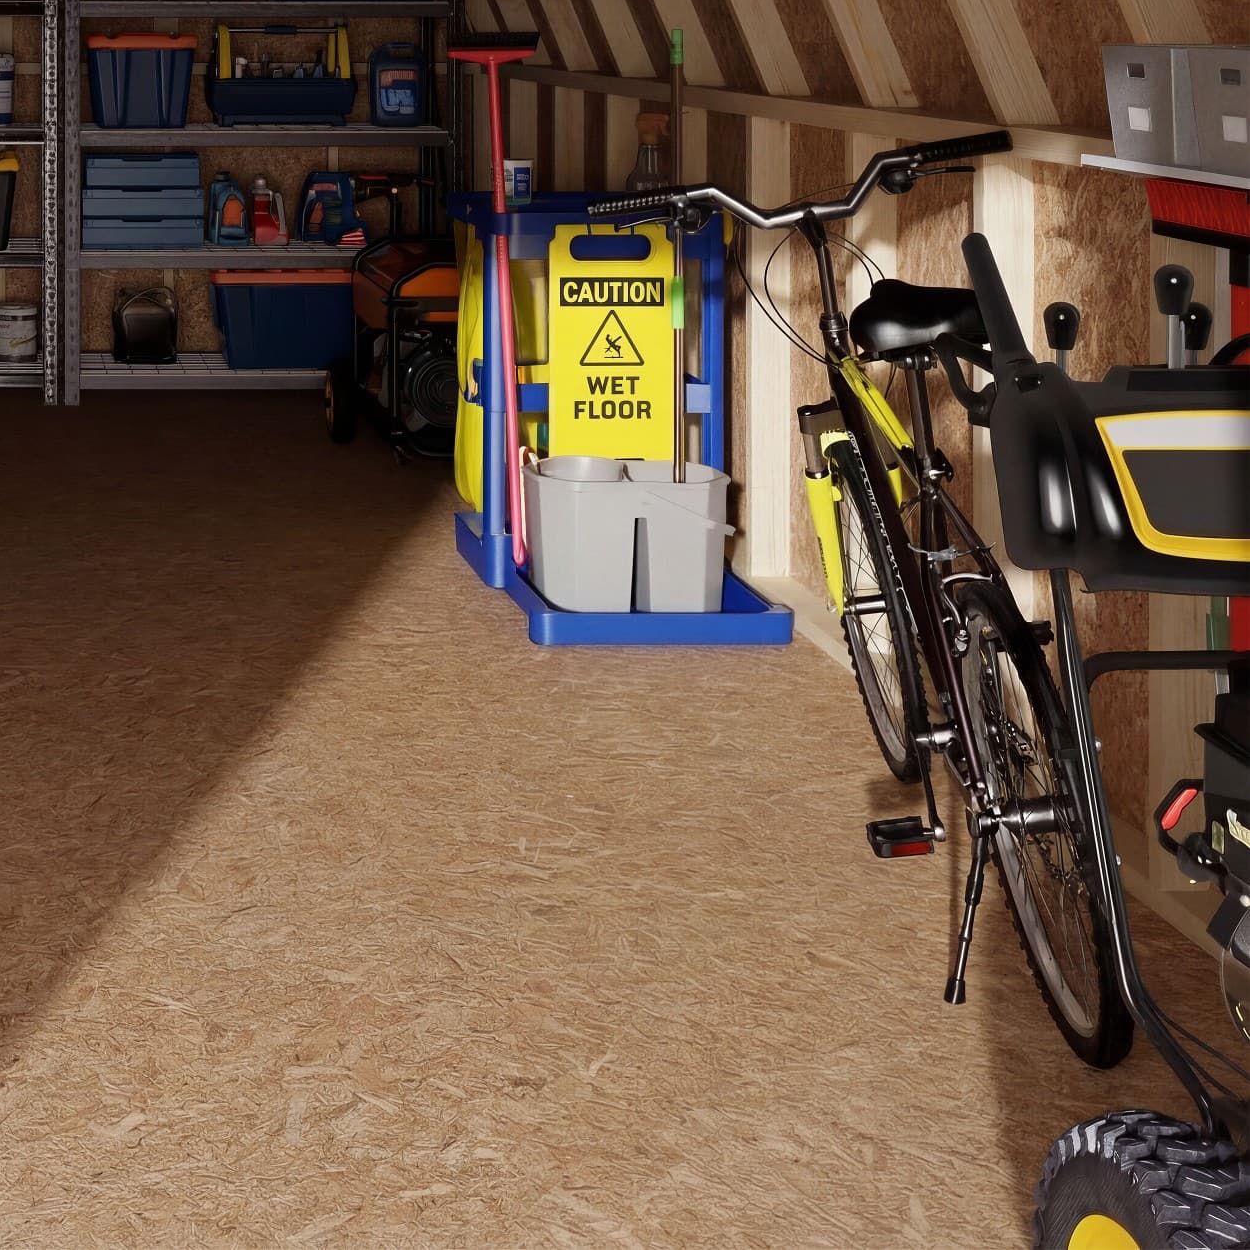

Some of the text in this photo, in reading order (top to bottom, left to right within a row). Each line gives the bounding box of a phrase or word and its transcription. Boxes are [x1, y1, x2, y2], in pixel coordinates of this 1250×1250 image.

[563, 281, 661, 303] CAUTION
[586, 376, 640, 395] WET
[574, 400, 651, 419] FLOOR
